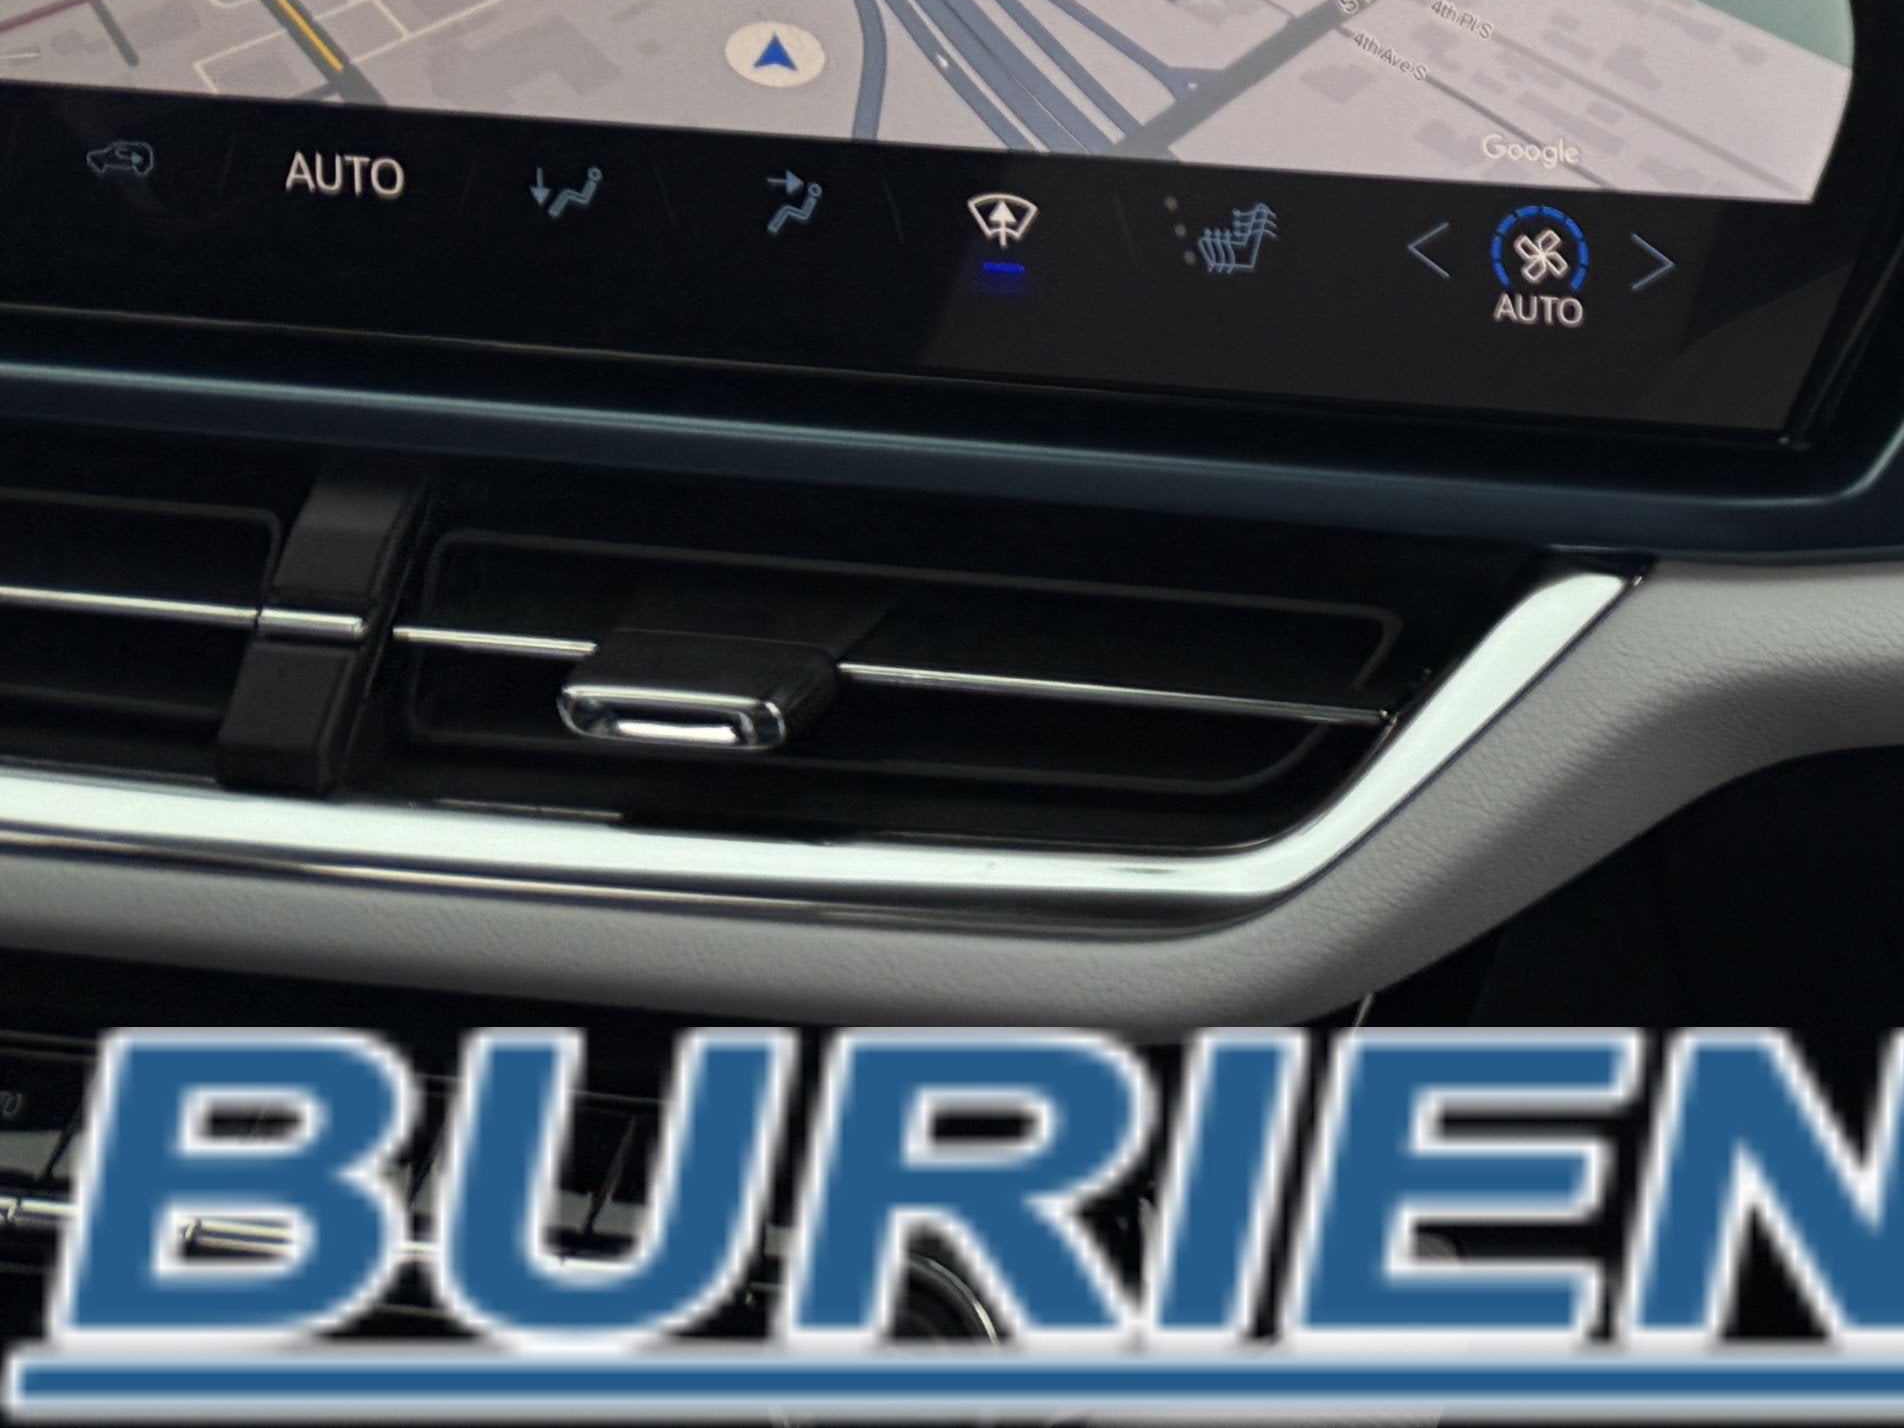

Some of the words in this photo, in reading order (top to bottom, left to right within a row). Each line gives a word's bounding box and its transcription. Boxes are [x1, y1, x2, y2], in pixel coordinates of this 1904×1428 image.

[1431, 0, 1457, 24] 4th
[1459, 11, 1479, 32] Pl
[1479, 21, 1494, 40] S
[1353, 31, 1379, 56] 4th
[1380, 46, 1411, 73] Ave
[1413, 63, 1429, 82] S
[1483, 133, 1581, 170] Google
[284, 150, 406, 199] AUTO
[1494, 291, 1584, 329] AUTO
